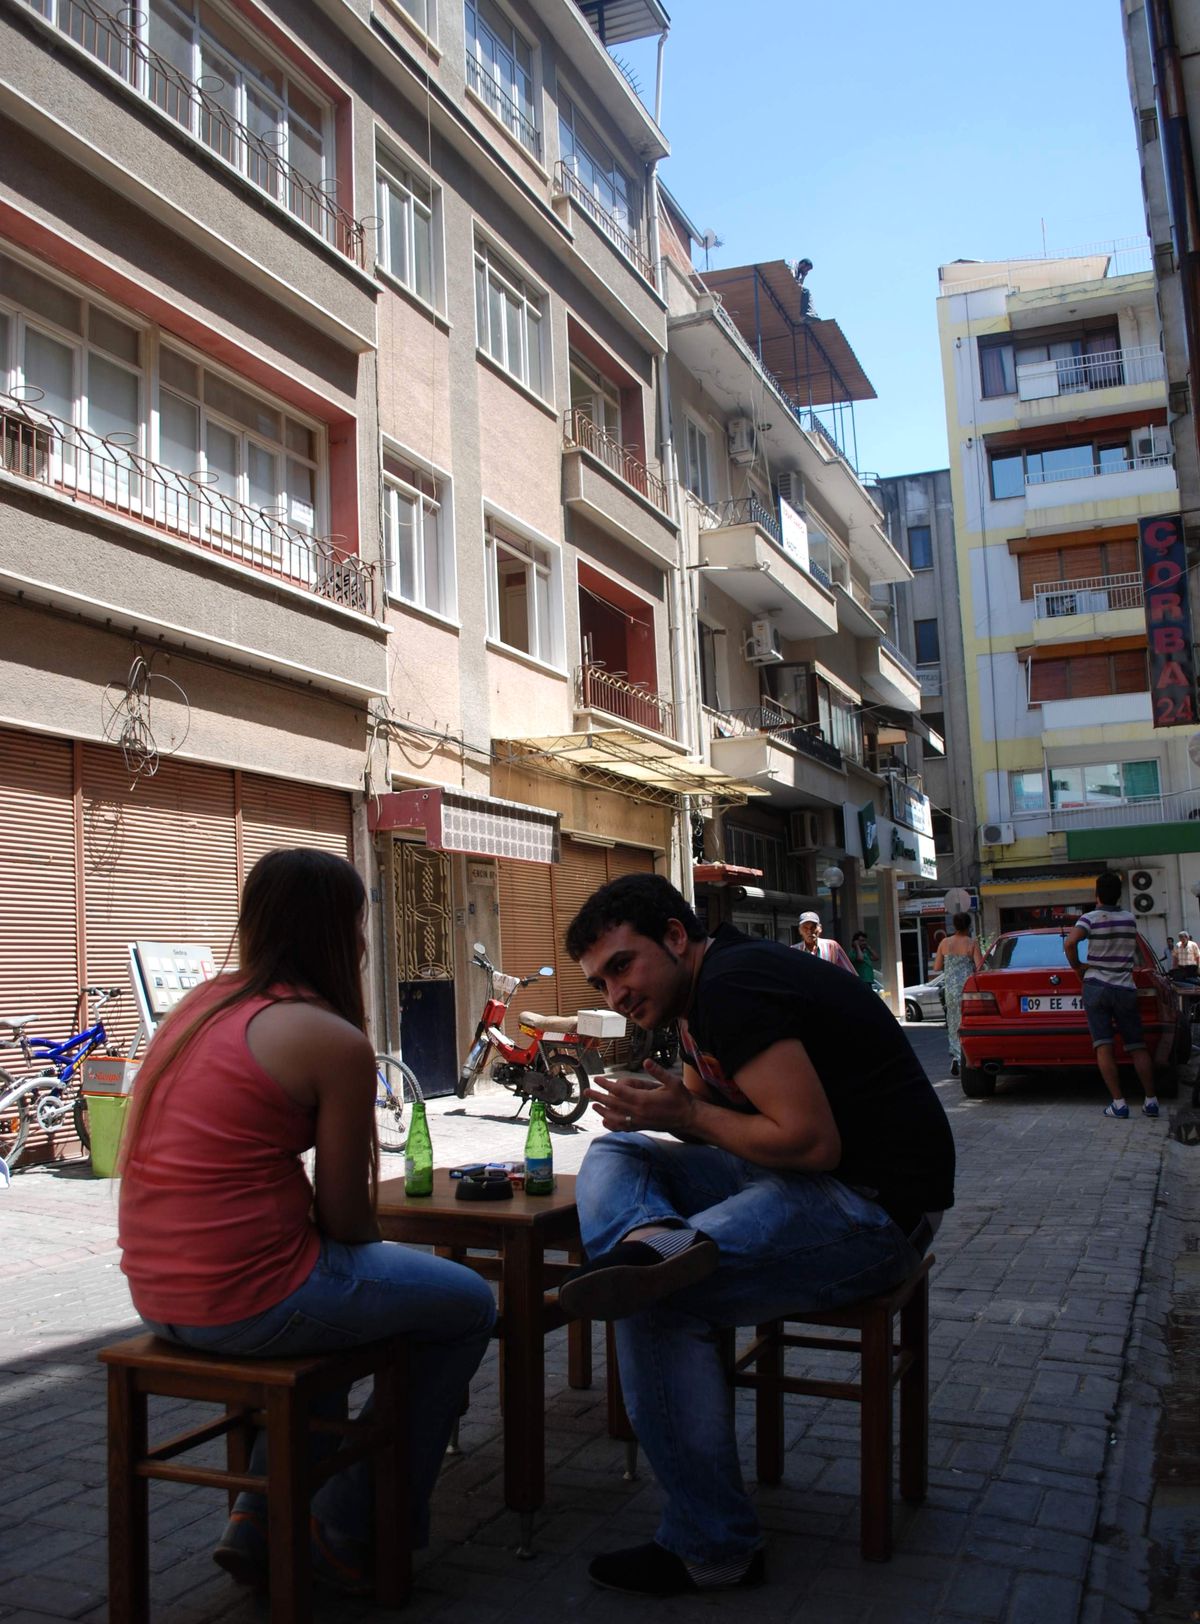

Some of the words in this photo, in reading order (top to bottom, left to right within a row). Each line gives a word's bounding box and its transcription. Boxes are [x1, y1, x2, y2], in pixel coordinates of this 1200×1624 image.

[1143, 522, 1188, 689] ÇORBA
[1156, 695, 1194, 723] 24
[1028, 998, 1041, 1010] 09
[1050, 998, 1062, 1010] EE
[1071, 997, 1086, 1010] 41
